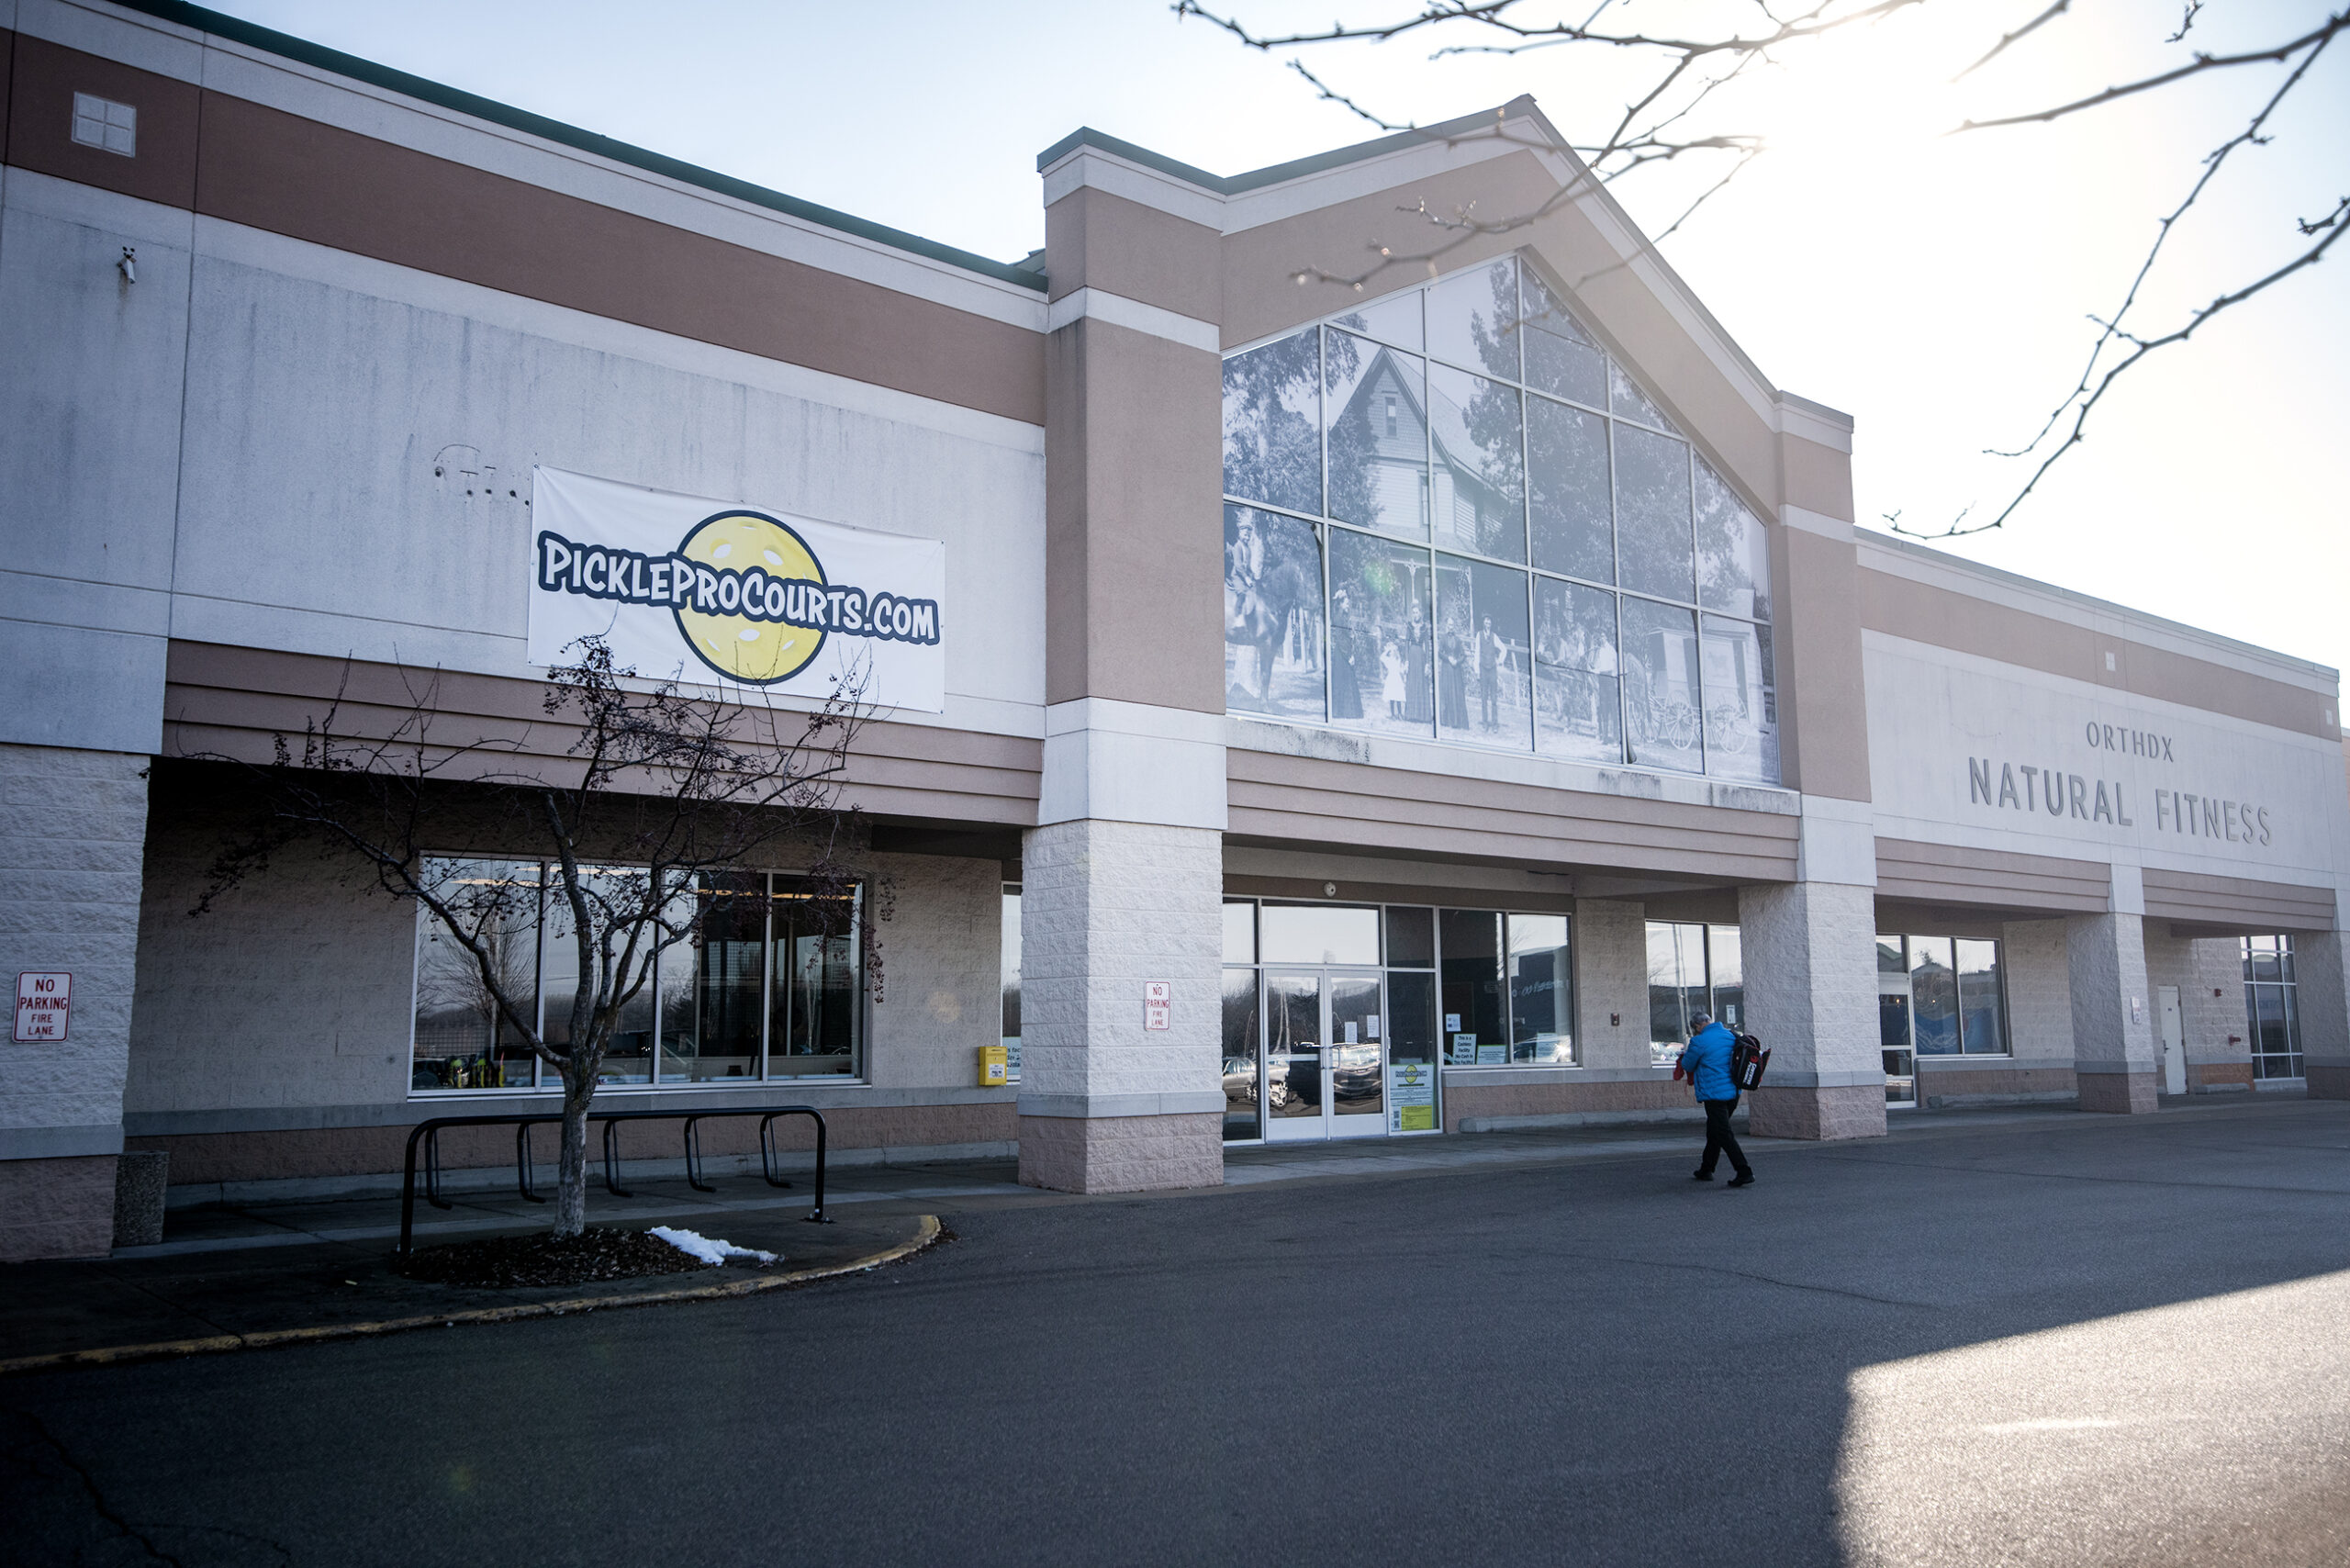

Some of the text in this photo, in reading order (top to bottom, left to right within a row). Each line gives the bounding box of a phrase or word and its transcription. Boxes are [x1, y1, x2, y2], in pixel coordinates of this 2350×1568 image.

[539, 531, 938, 644] PICKLEPROCOURTS.COM
[2087, 722, 2174, 763] ORTHDX
[1969, 756, 2271, 846] NATURAL FITNESS
[35, 979, 55, 992] NO
[1152, 986, 1163, 996] NO
[19, 997, 67, 1010] PARKING
[1147, 998, 1169, 1009] PARKING
[31, 1014, 53, 1023] FIRE
[1152, 1010, 1163, 1018] FIRE
[28, 1025, 54, 1036] LANE
